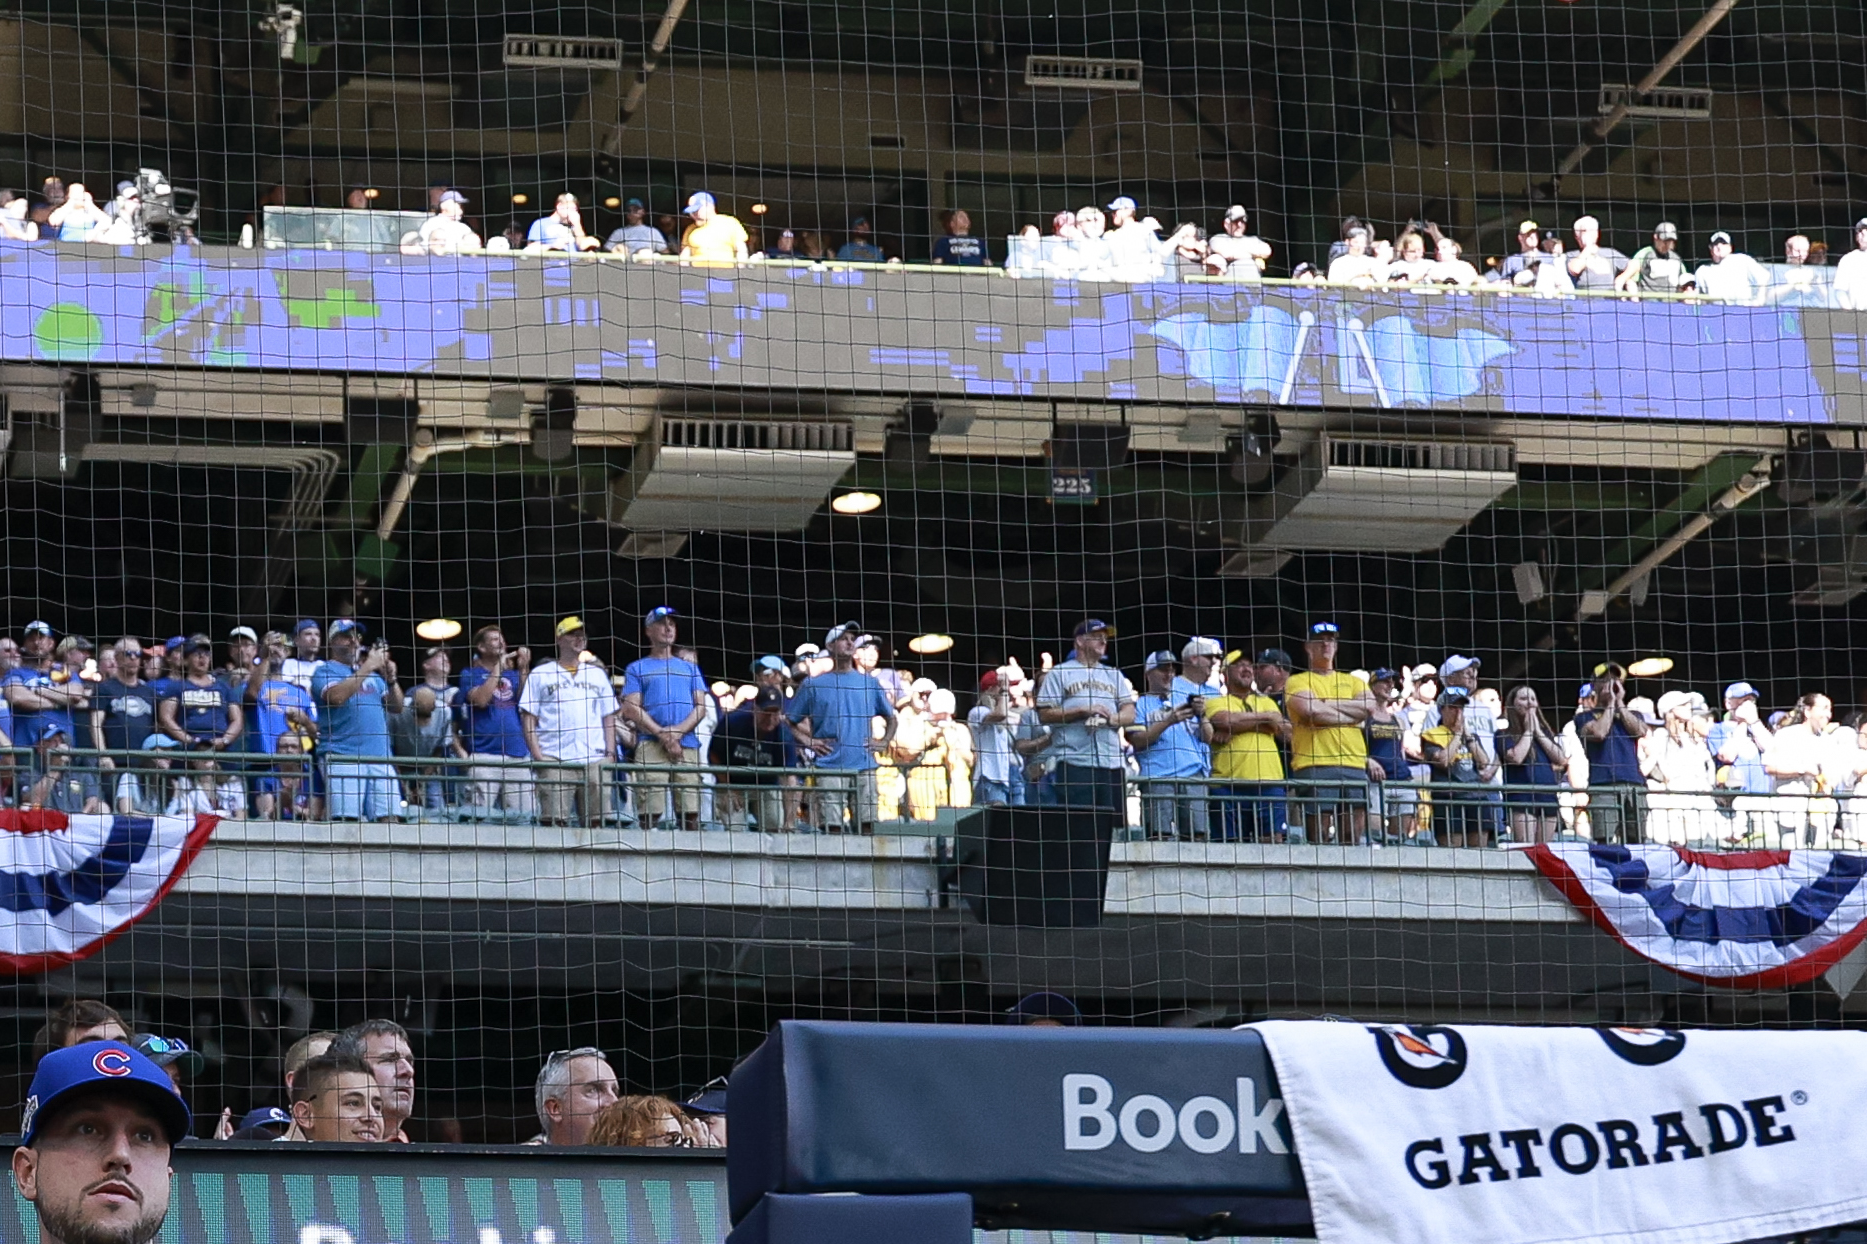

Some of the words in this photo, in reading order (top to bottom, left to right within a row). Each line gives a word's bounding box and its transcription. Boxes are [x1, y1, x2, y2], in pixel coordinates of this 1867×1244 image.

[1052, 477, 1092, 495] 225
[92, 1048, 132, 1078] C
[1062, 1073, 1296, 1155] Book
[1405, 1095, 1796, 1190] GATORADE
